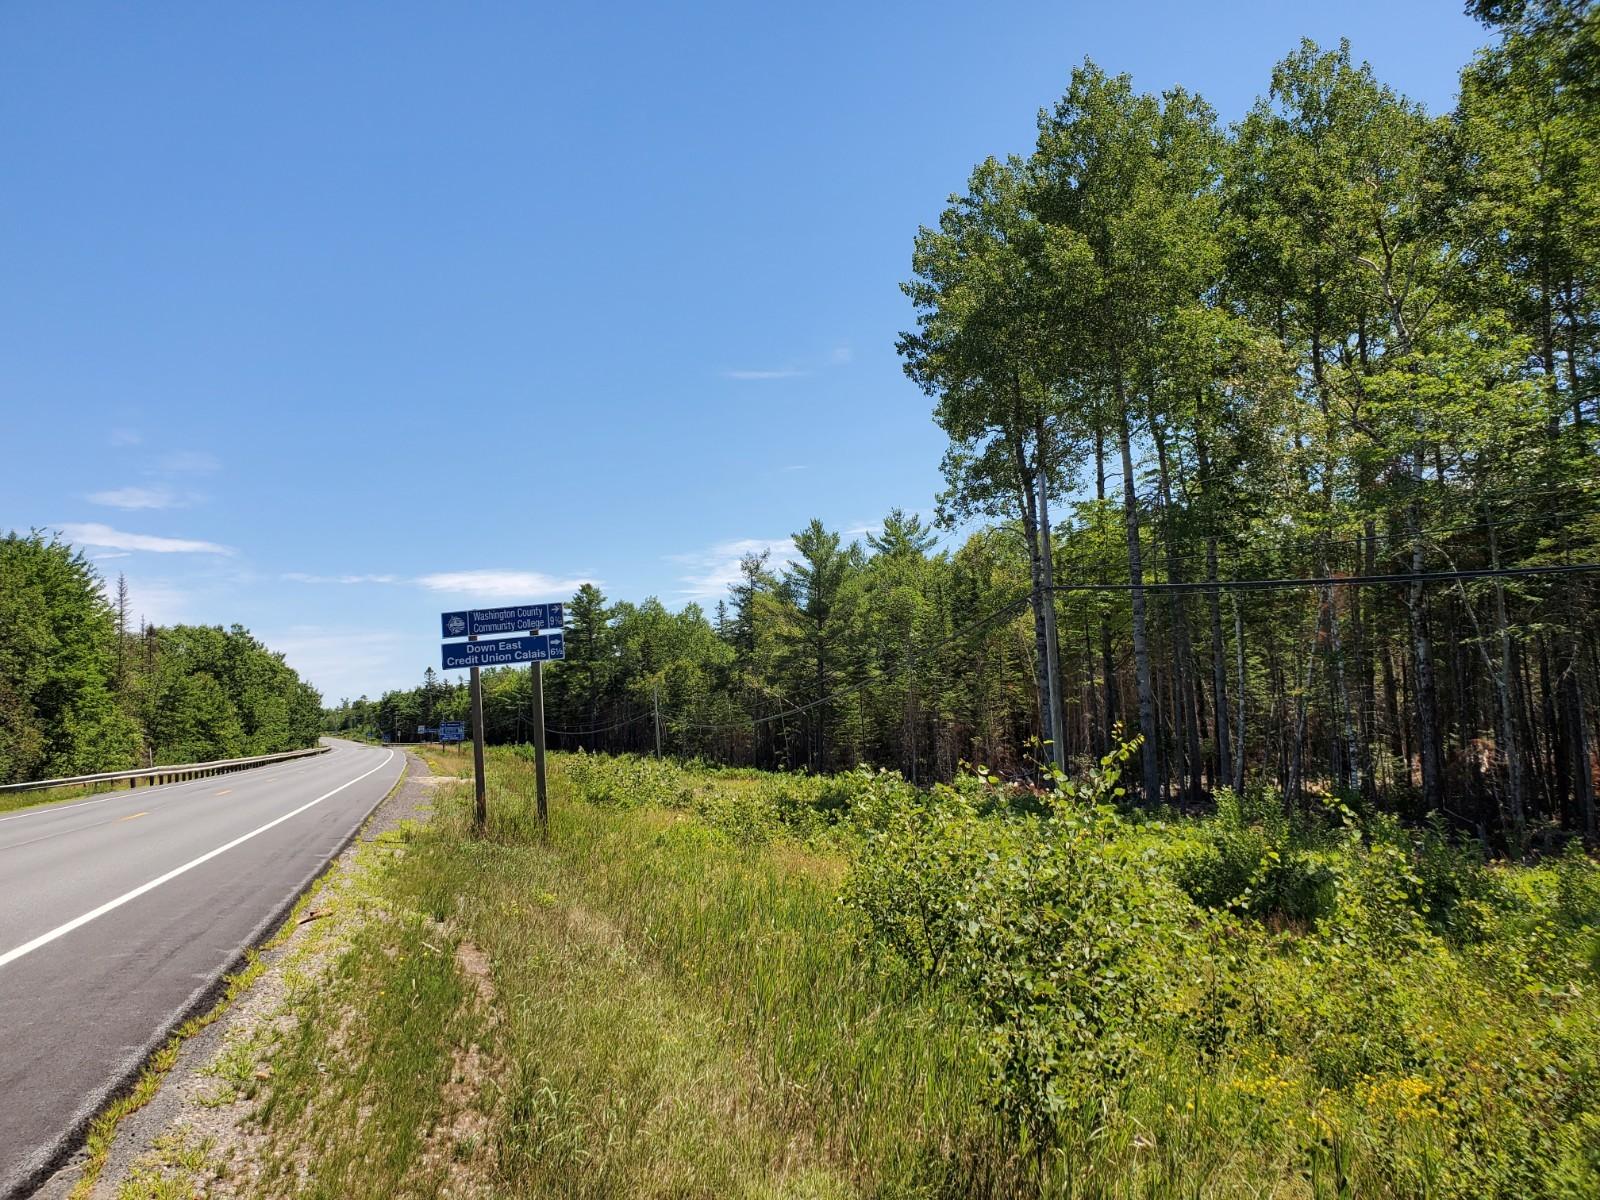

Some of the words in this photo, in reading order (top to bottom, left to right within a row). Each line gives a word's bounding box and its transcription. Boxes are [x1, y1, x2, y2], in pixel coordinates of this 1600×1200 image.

[473, 609, 516, 621] Washington
[518, 606, 542, 618] County
[473, 621, 516, 633] Community
[518, 618, 544, 630] College
[466, 644, 496, 654] Down
[498, 641, 522, 650] East
[447, 655, 478, 666] Credit
[482, 652, 512, 664] Union
[514, 650, 546, 660] Calais
